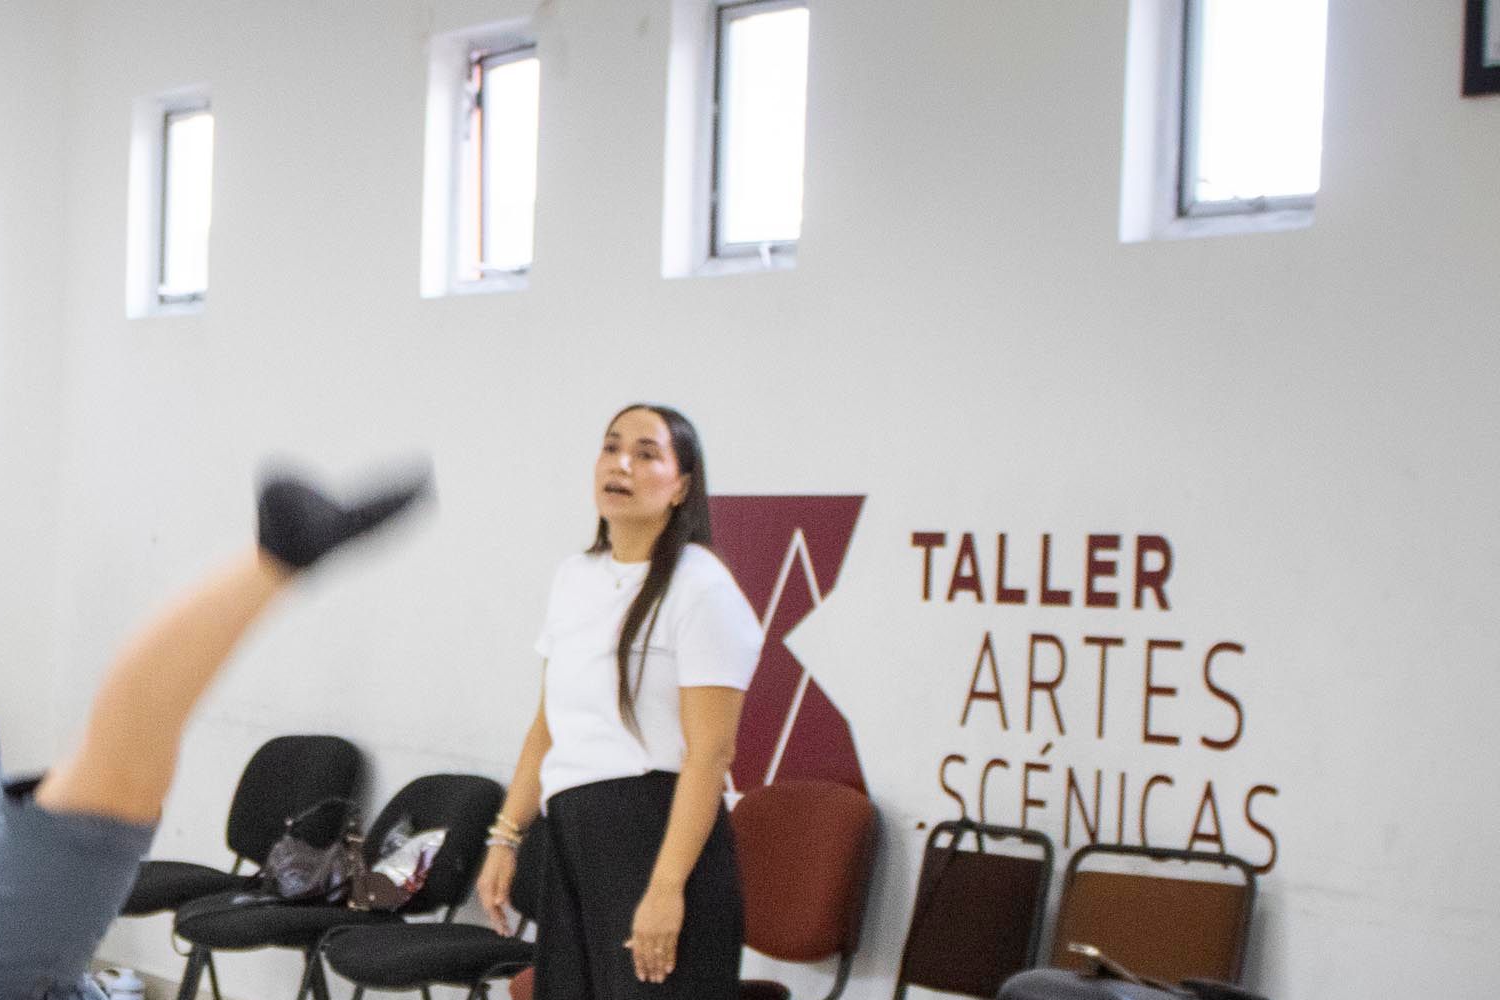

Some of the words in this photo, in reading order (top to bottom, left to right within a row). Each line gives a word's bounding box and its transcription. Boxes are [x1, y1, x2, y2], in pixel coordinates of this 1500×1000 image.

[911, 531, 1173, 611] TALLER
[960, 631, 1245, 752] ARTES
[937, 742, 1279, 875] SCÉNICAS
